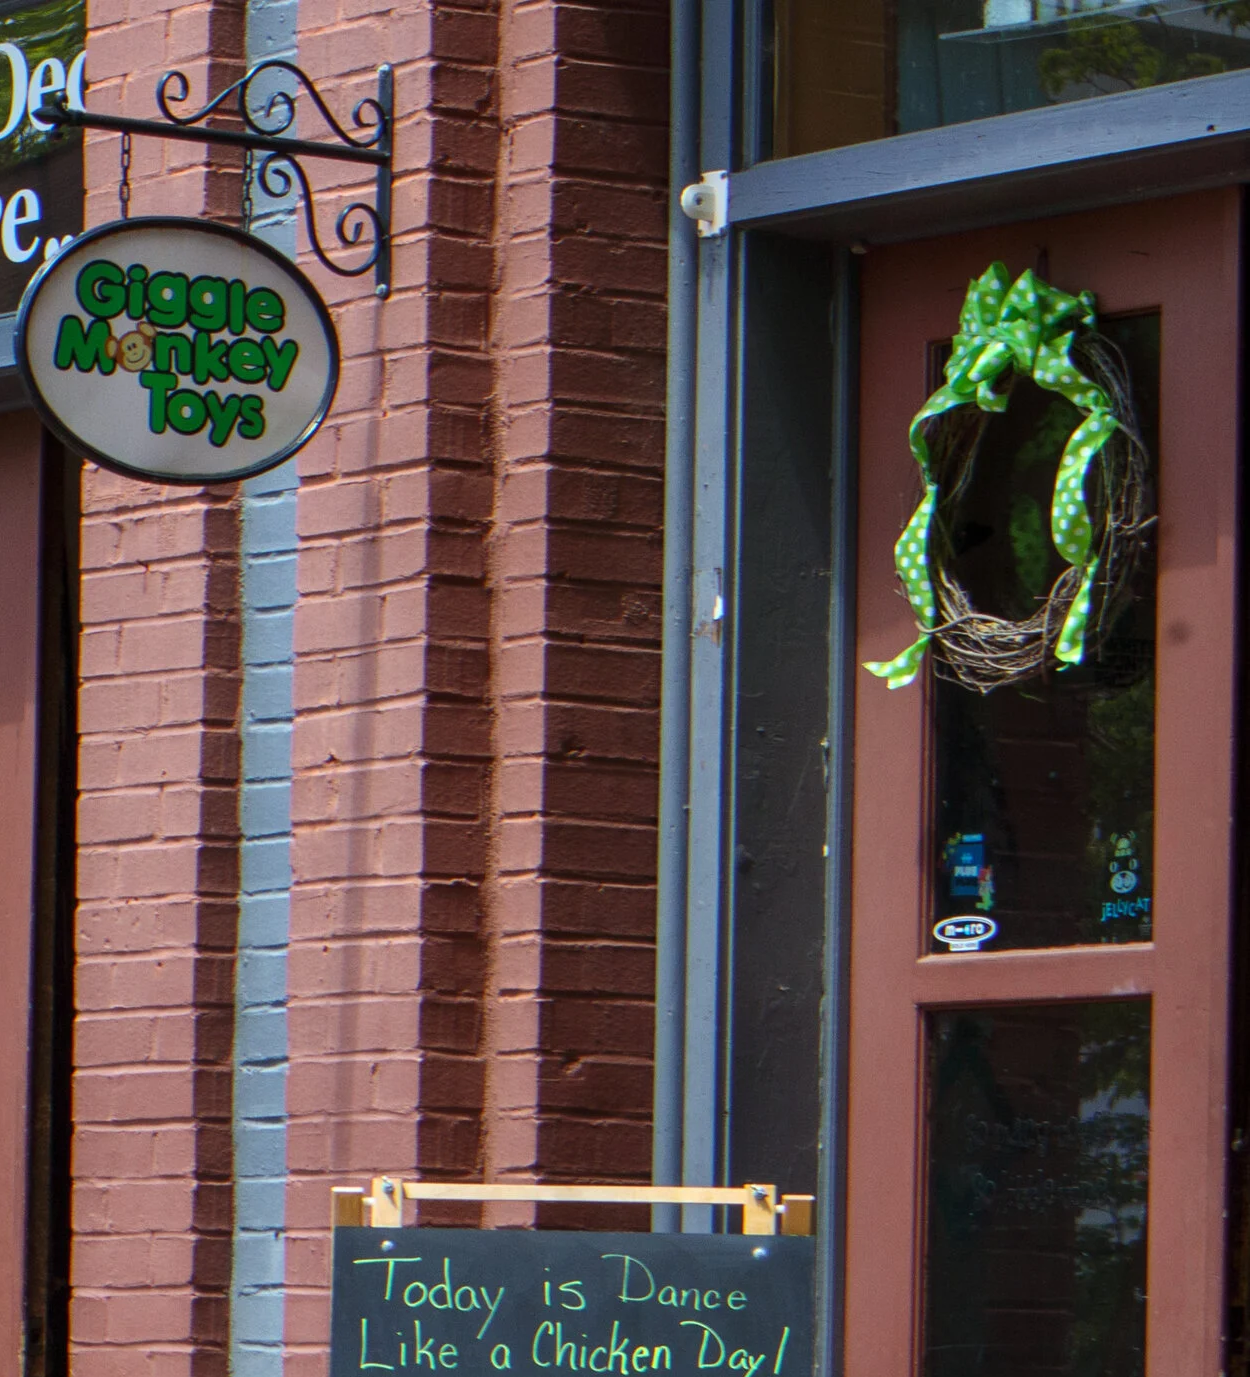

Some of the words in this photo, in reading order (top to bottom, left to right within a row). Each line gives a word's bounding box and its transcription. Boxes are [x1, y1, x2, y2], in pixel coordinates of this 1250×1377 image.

[76, 259, 286, 336] Giggle
[139, 370, 266, 448] Toys
[353, 1257, 505, 1339] Today
[543, 1267, 587, 1310] is
[601, 1254, 748, 1310] Dance
[359, 1318, 459, 1371] Like
[490, 1343, 512, 1370] a
[532, 1320, 672, 1376] Chicken
